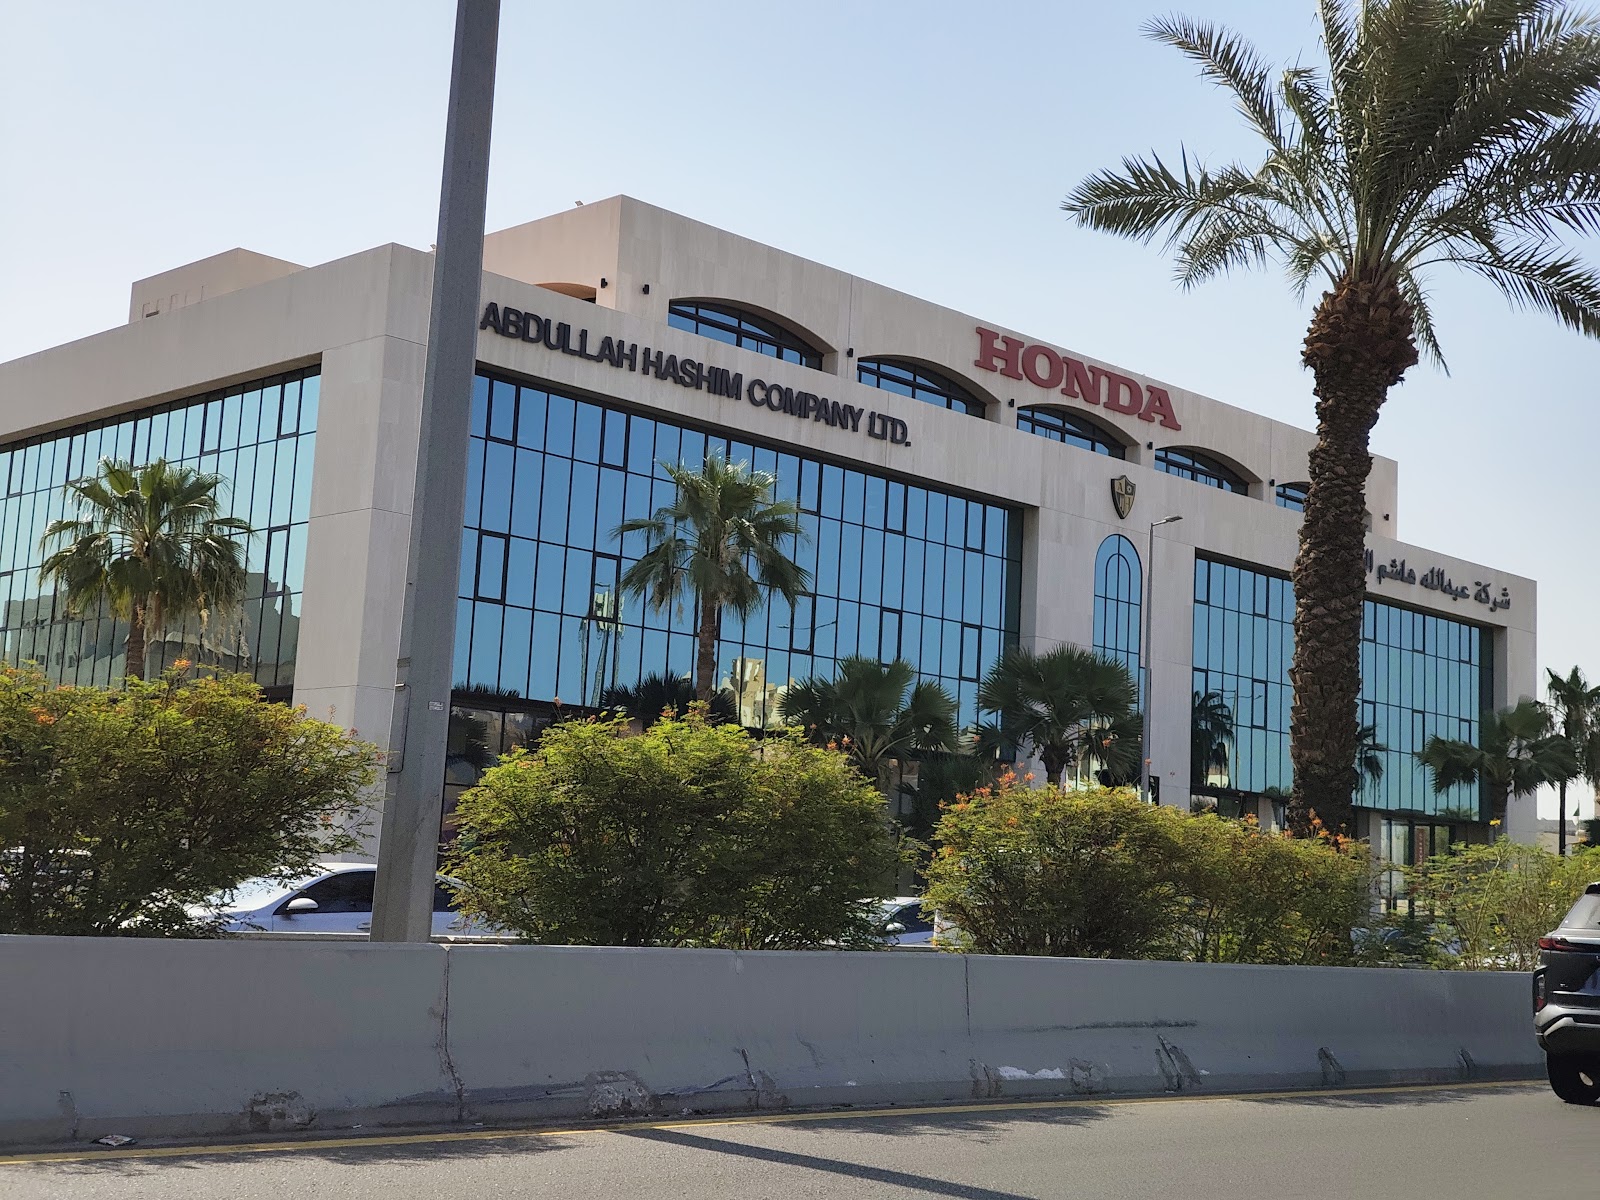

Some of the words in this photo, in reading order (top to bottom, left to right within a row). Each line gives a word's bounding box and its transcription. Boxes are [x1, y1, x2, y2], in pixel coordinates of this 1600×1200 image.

[480, 301, 638, 372] ABDULLAH
[642, 347, 743, 401] HASHIM
[747, 378, 865, 432] COMPANY
[868, 410, 912, 447] LTD.
[974, 326, 1182, 431] HONDA
[1377, 558, 1417, 585] هاشم
[1474, 580, 1511, 613] شركة
